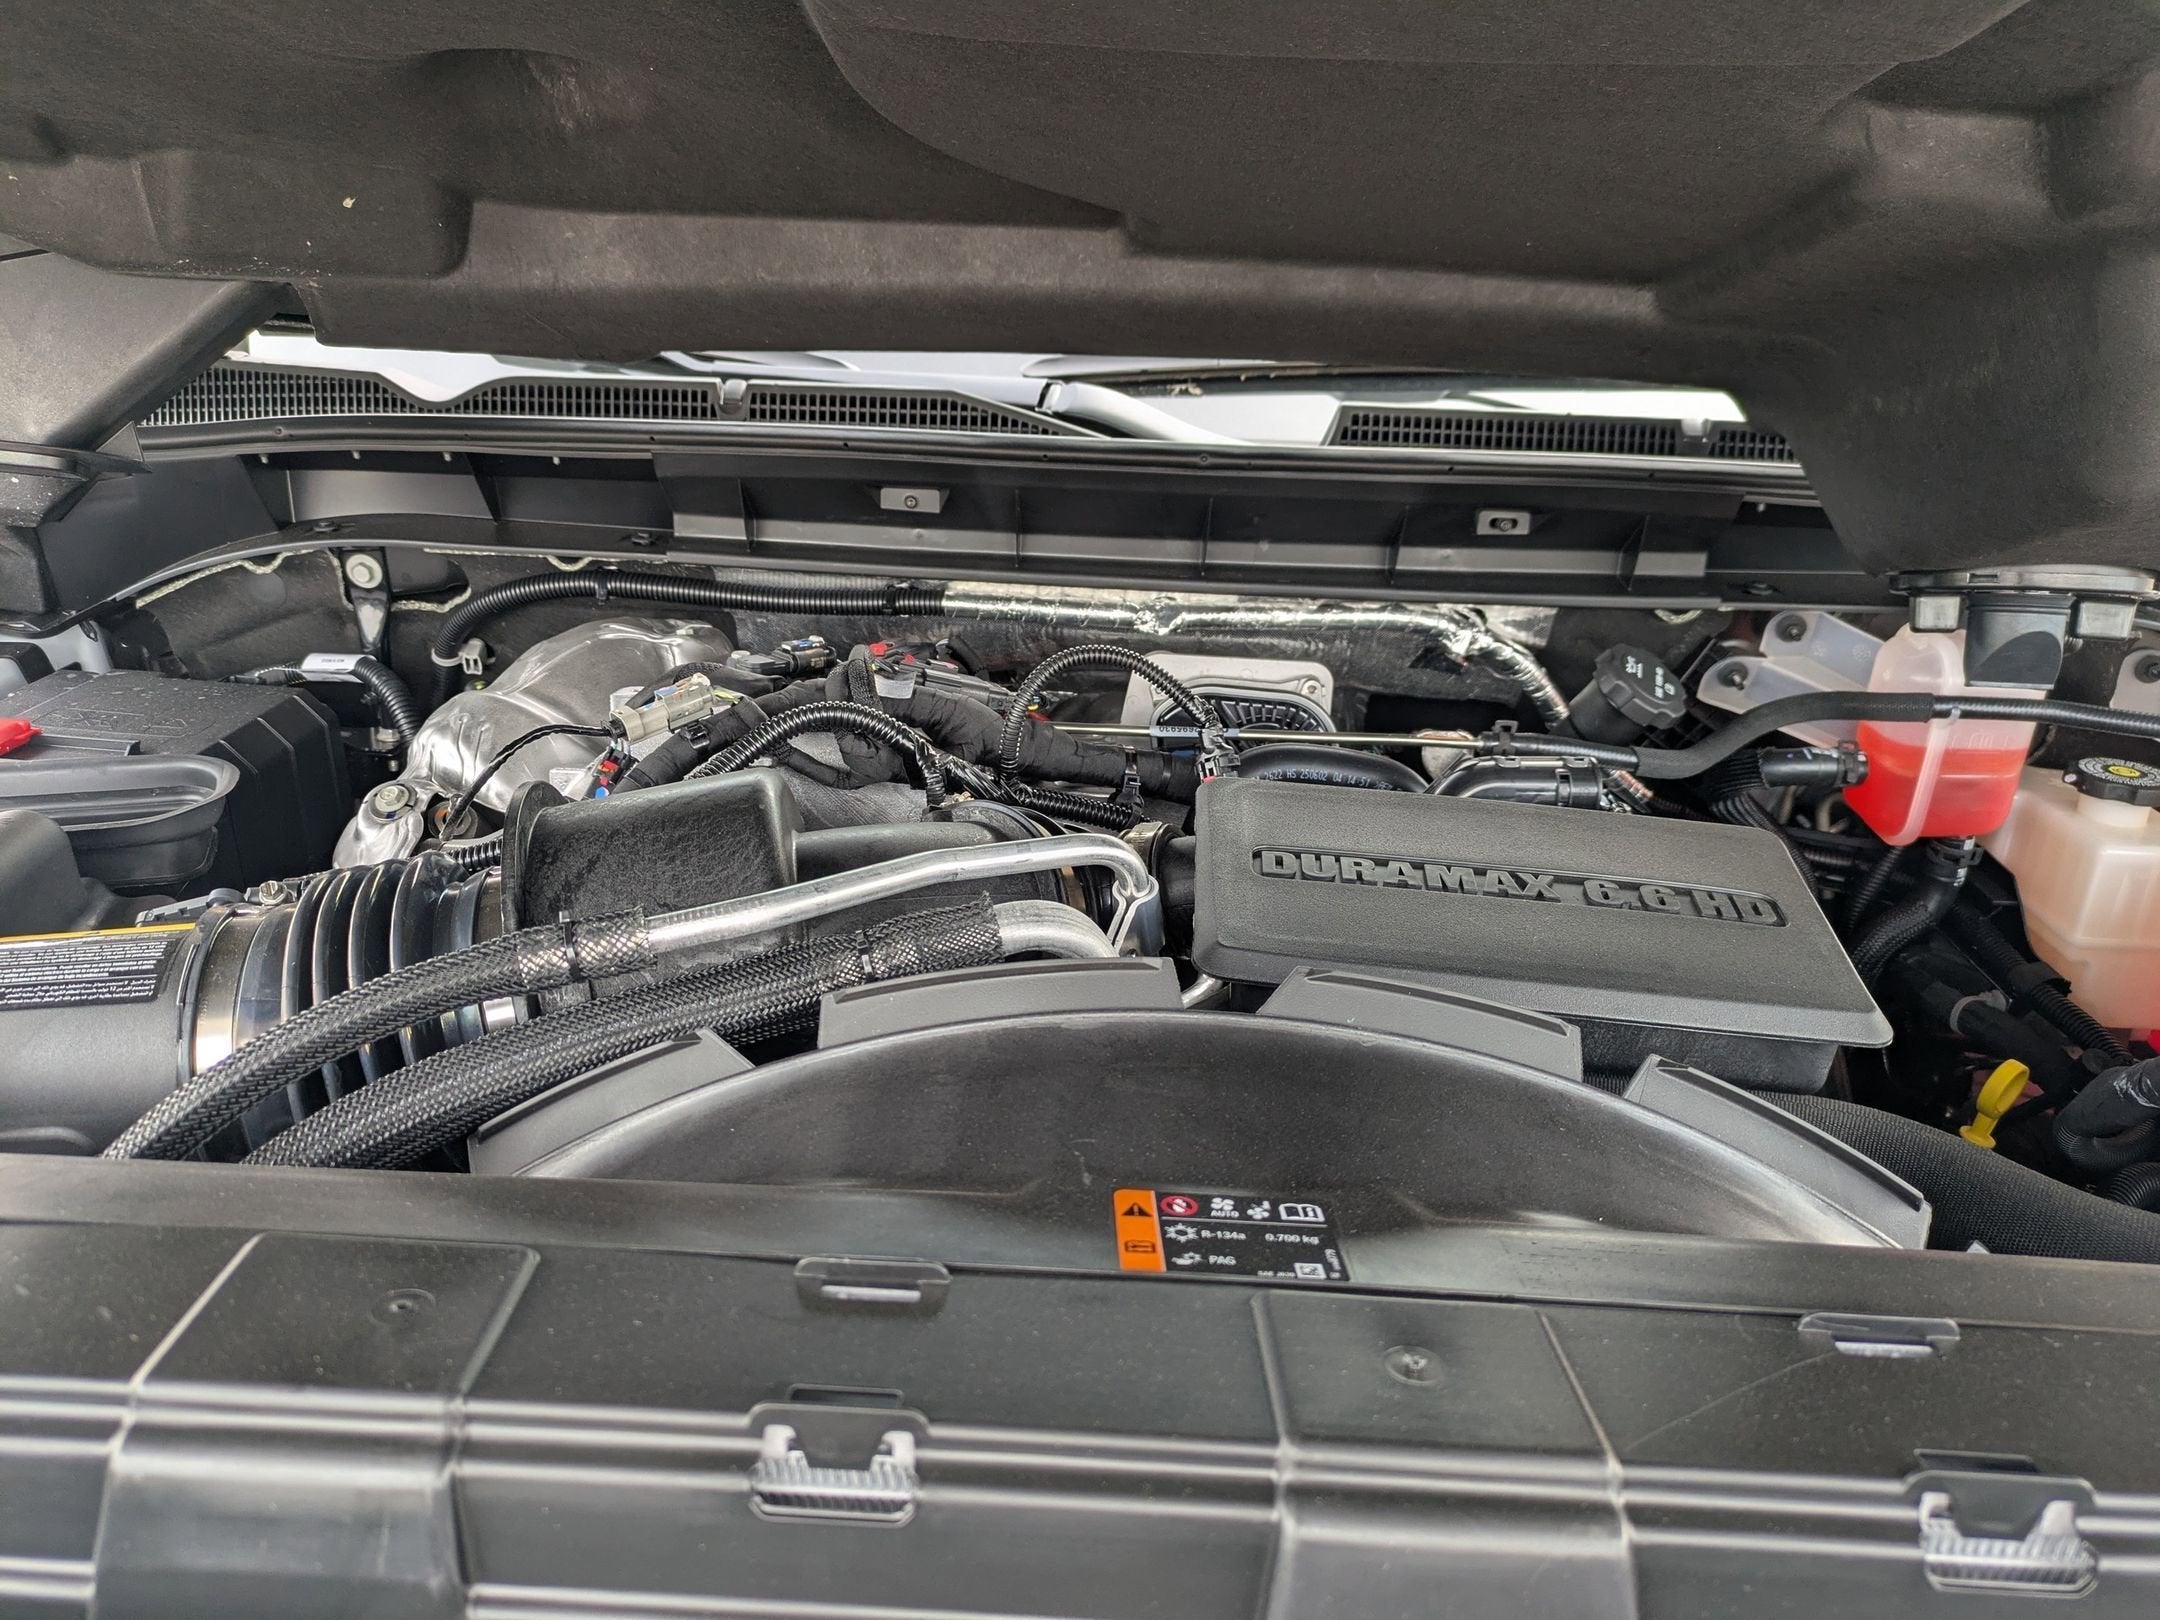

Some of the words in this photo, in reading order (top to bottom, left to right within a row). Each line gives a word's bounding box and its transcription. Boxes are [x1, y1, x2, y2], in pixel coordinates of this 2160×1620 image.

[1286, 768, 1297, 779] HS
[1300, 768, 1328, 781] 250602
[1260, 849, 1562, 903] DURAMAX
[1583, 879, 1681, 915] 6.6
[1690, 889, 1785, 927] HD
[1211, 1209, 1239, 1218] AUTO
[1201, 1230, 1246, 1240] R-134a
[1302, 1235, 1320, 1245] kg
[1208, 1255, 1237, 1266] PAG
